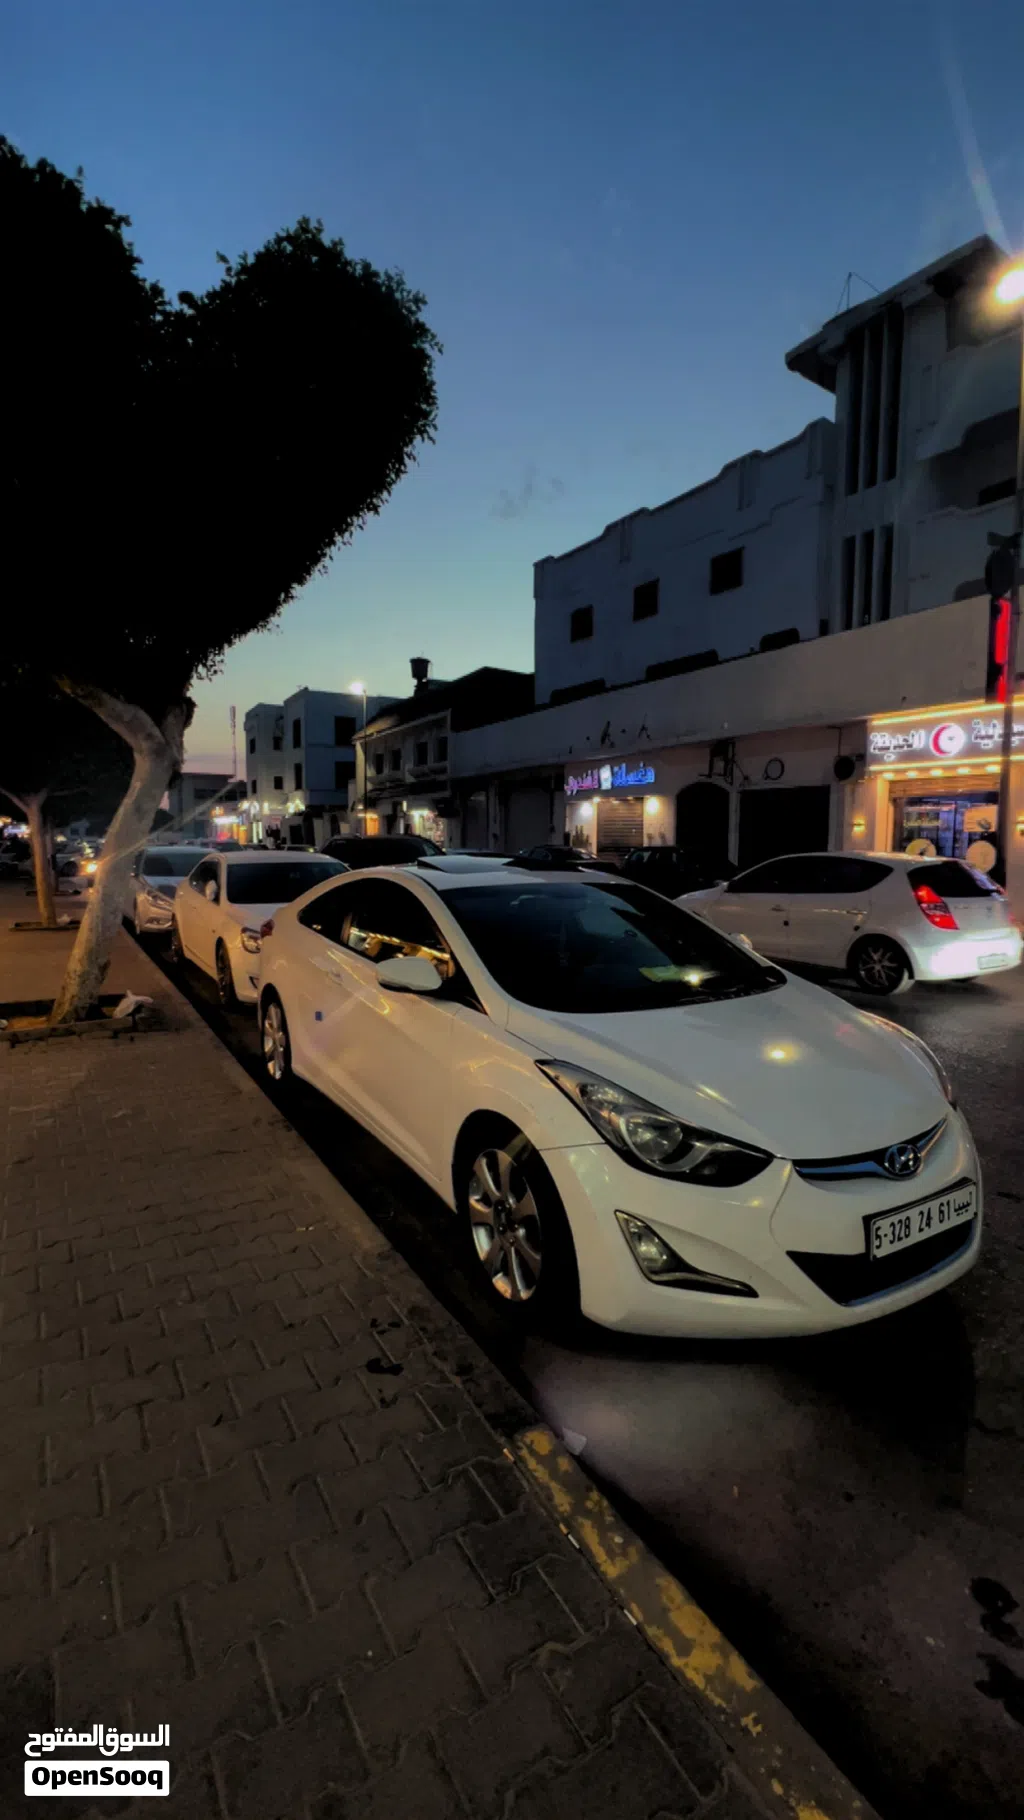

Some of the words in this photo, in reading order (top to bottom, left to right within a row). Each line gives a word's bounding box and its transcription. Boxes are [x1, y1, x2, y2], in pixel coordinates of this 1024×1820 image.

[875, 1216, 911, 1250] 5-328
[918, 1207, 933, 1233] 24
[938, 1200, 951, 1224] 61
[953, 1191, 973, 1217] ليبيا
